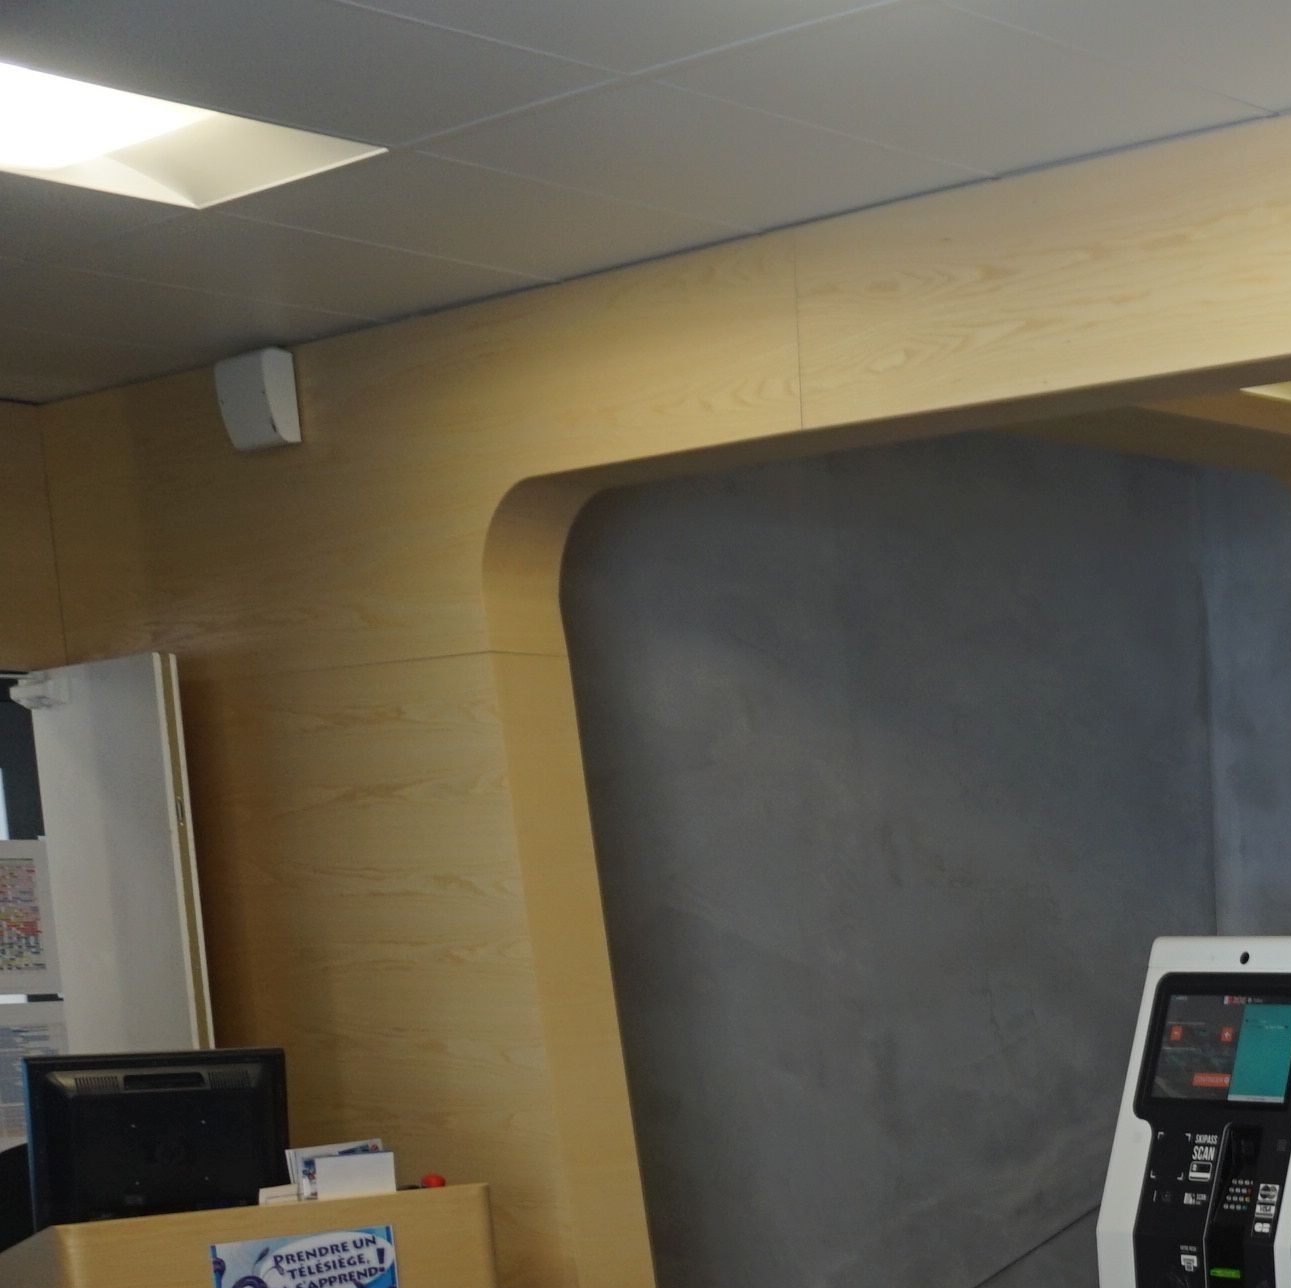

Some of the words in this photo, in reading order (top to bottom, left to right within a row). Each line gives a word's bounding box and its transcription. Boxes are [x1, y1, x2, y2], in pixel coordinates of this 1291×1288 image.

[1195, 1134, 1218, 1144] SKIPASS
[1192, 1145, 1216, 1161] SCAN
[273, 1241, 349, 1267] PRENDRE
[353, 1235, 377, 1250] UN
